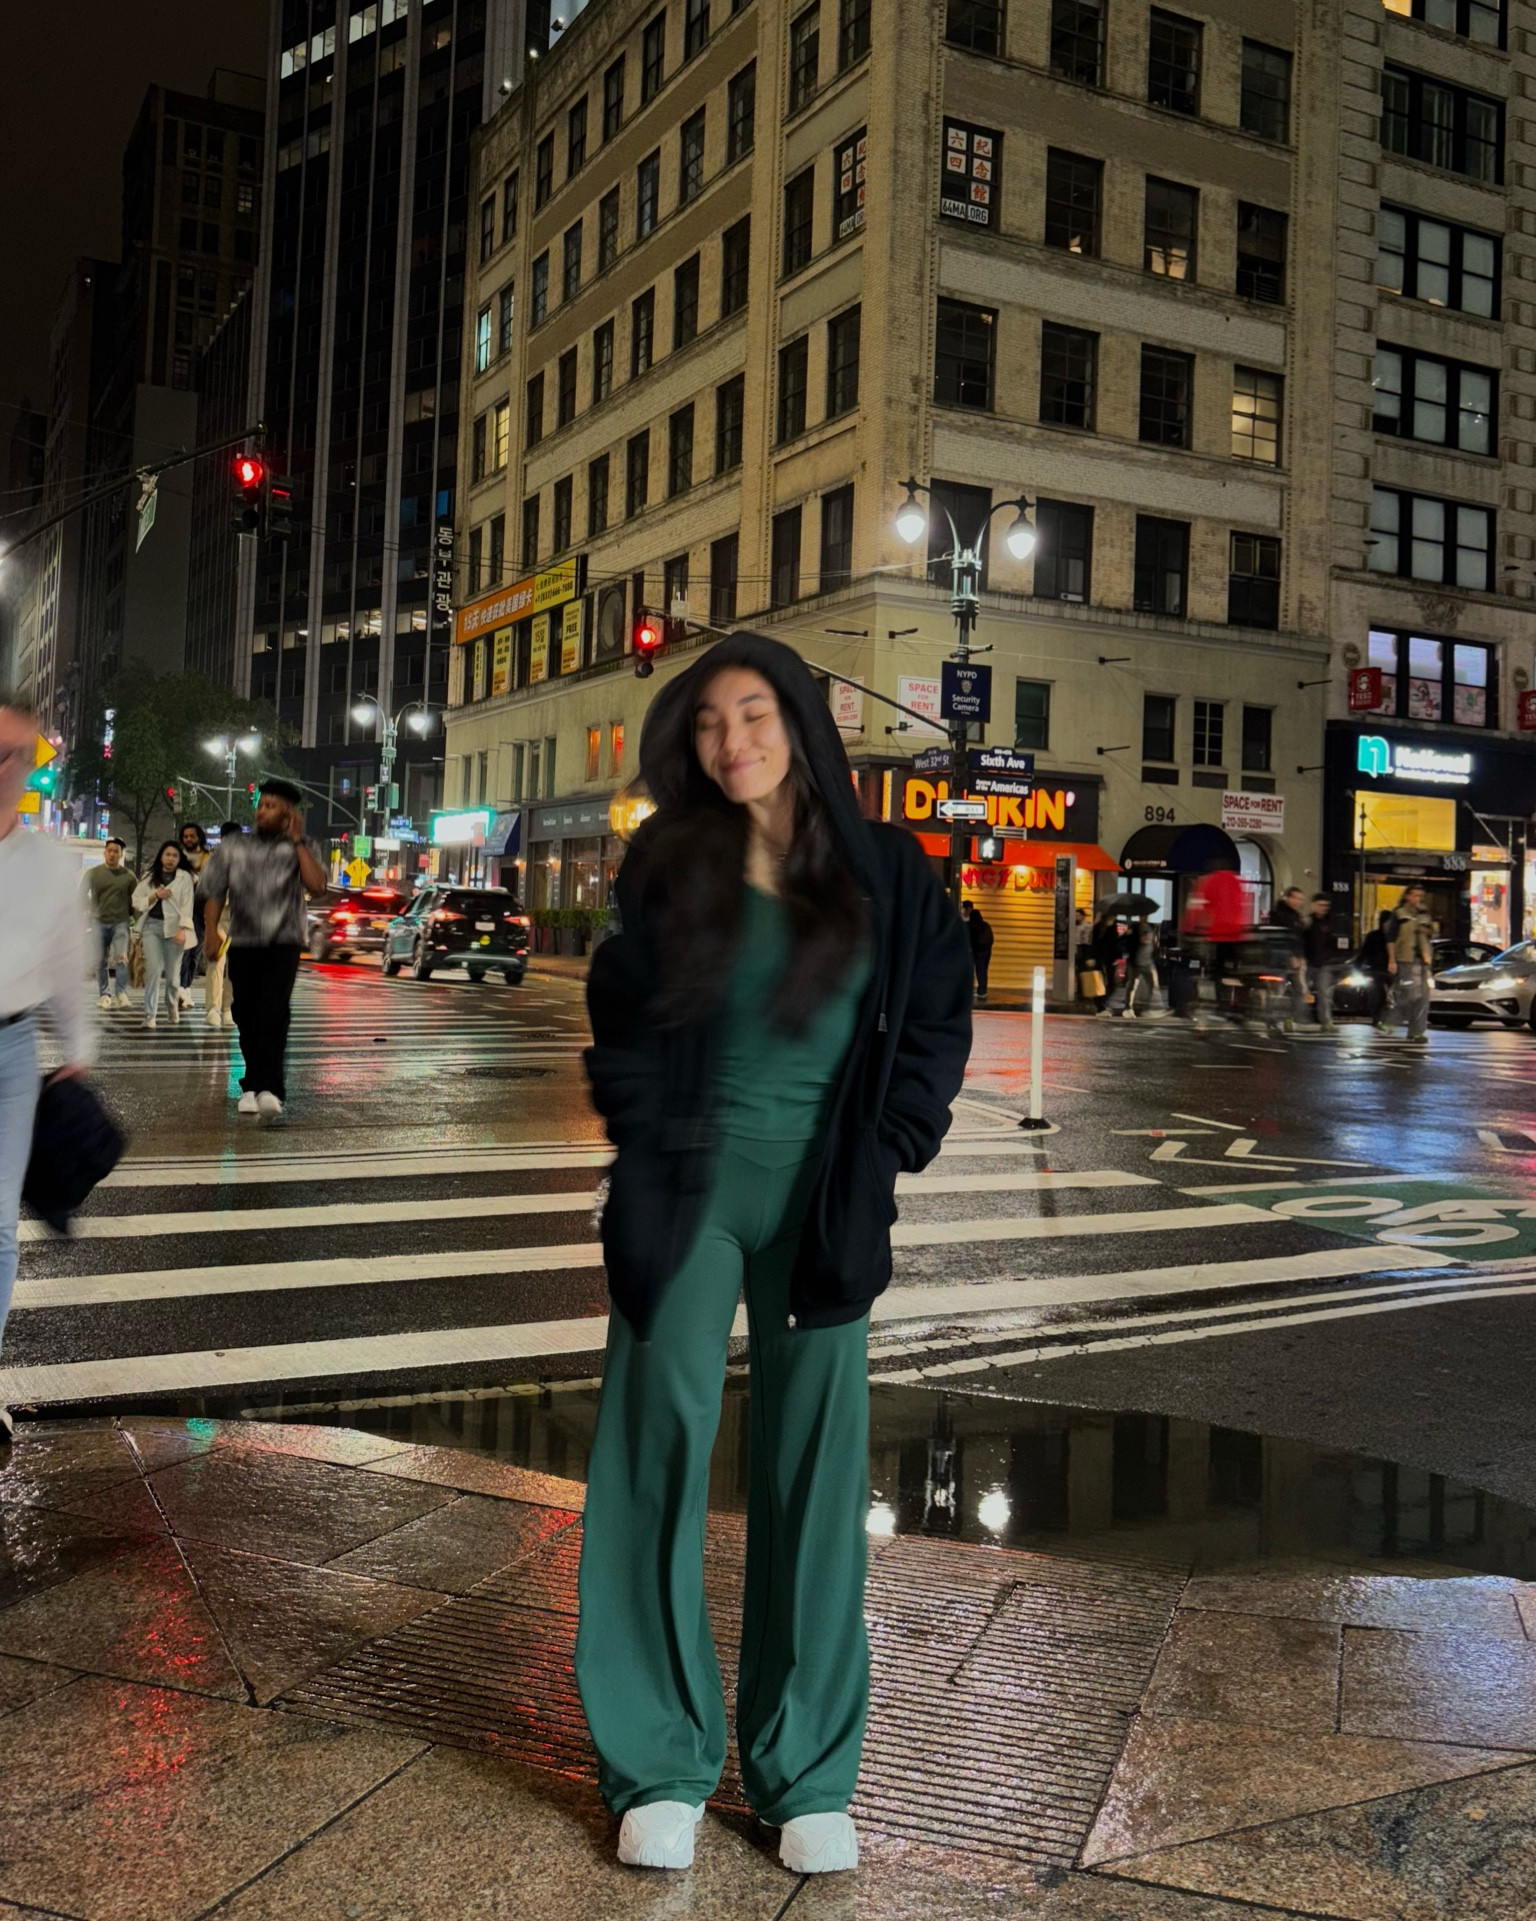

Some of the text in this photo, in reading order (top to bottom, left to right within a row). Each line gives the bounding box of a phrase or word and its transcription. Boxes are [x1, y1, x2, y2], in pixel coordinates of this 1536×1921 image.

[956, 670, 978, 679] NYPD
[908, 682, 939, 694] SPACE
[910, 701, 935, 711] RENT
[952, 694, 981, 706] Security
[840, 702, 855, 712] RENT
[952, 702, 980, 712] Camera
[914, 757, 930, 769] West
[943, 754, 950, 766] St
[980, 754, 1026, 769] Sixth Ave
[990, 780, 1029, 795] Americas
[1223, 795, 1283, 813] SPACE FOR RENT
[1144, 805, 1175, 823] 894
[1443, 855, 1466, 871] 888
[1333, 881, 1349, 892] 888
